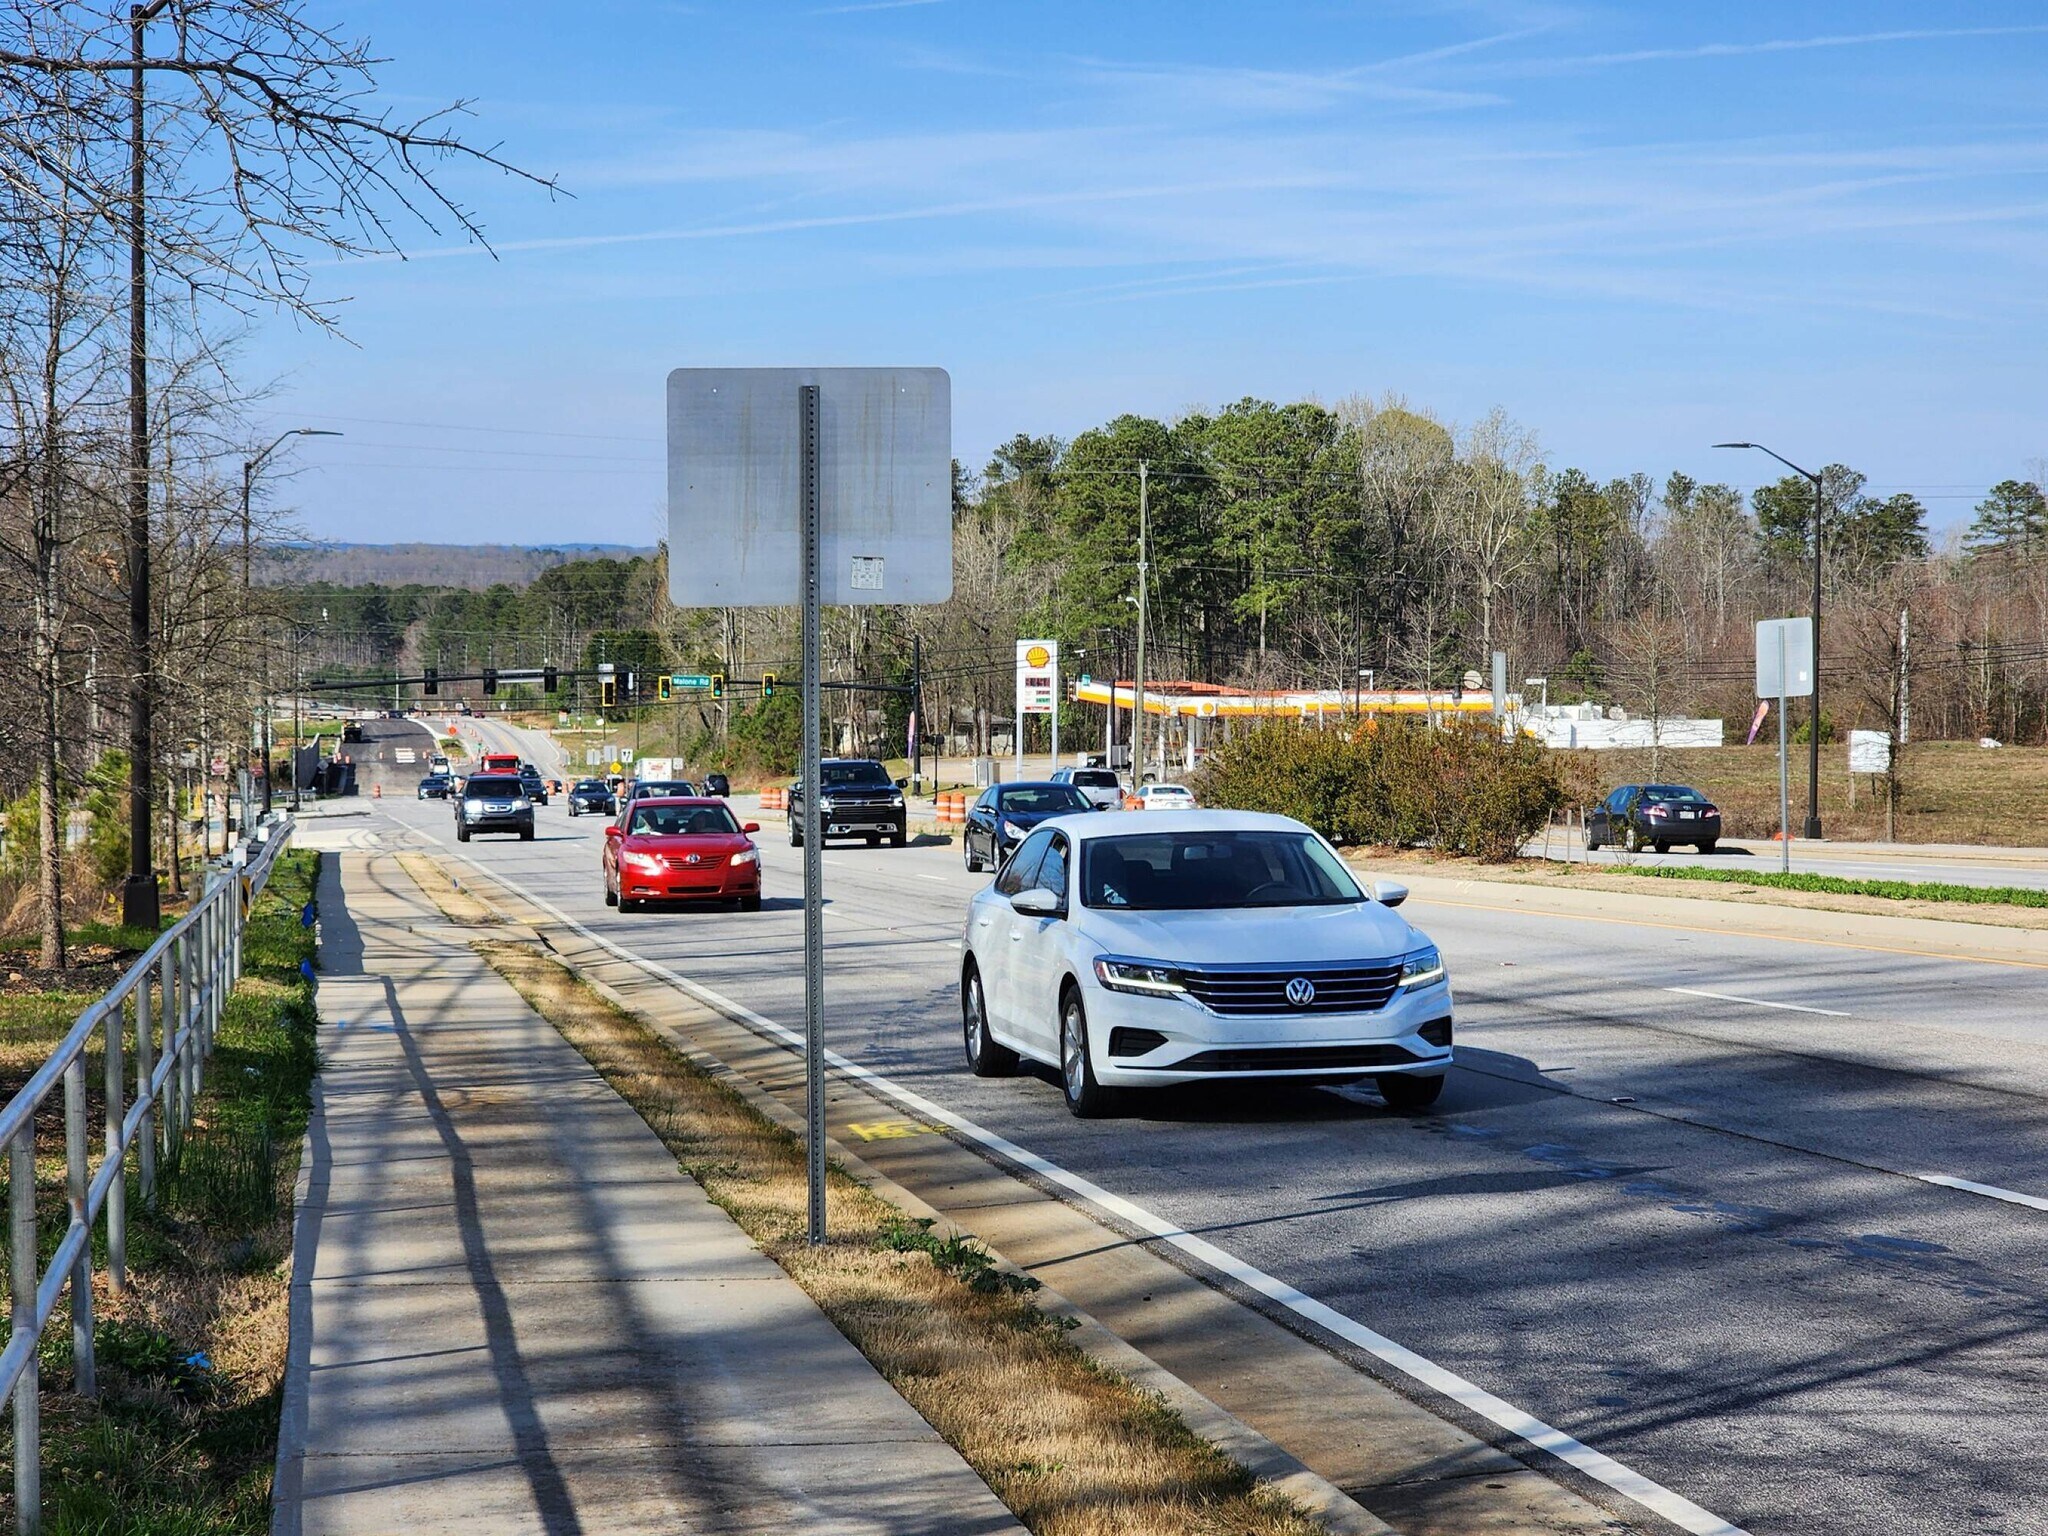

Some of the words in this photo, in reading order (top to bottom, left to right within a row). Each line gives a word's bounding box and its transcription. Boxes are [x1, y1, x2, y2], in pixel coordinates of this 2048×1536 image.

[673, 678, 697, 686] Malone
[699, 678, 709, 686] Rd
[1286, 977, 1315, 1006] VW
